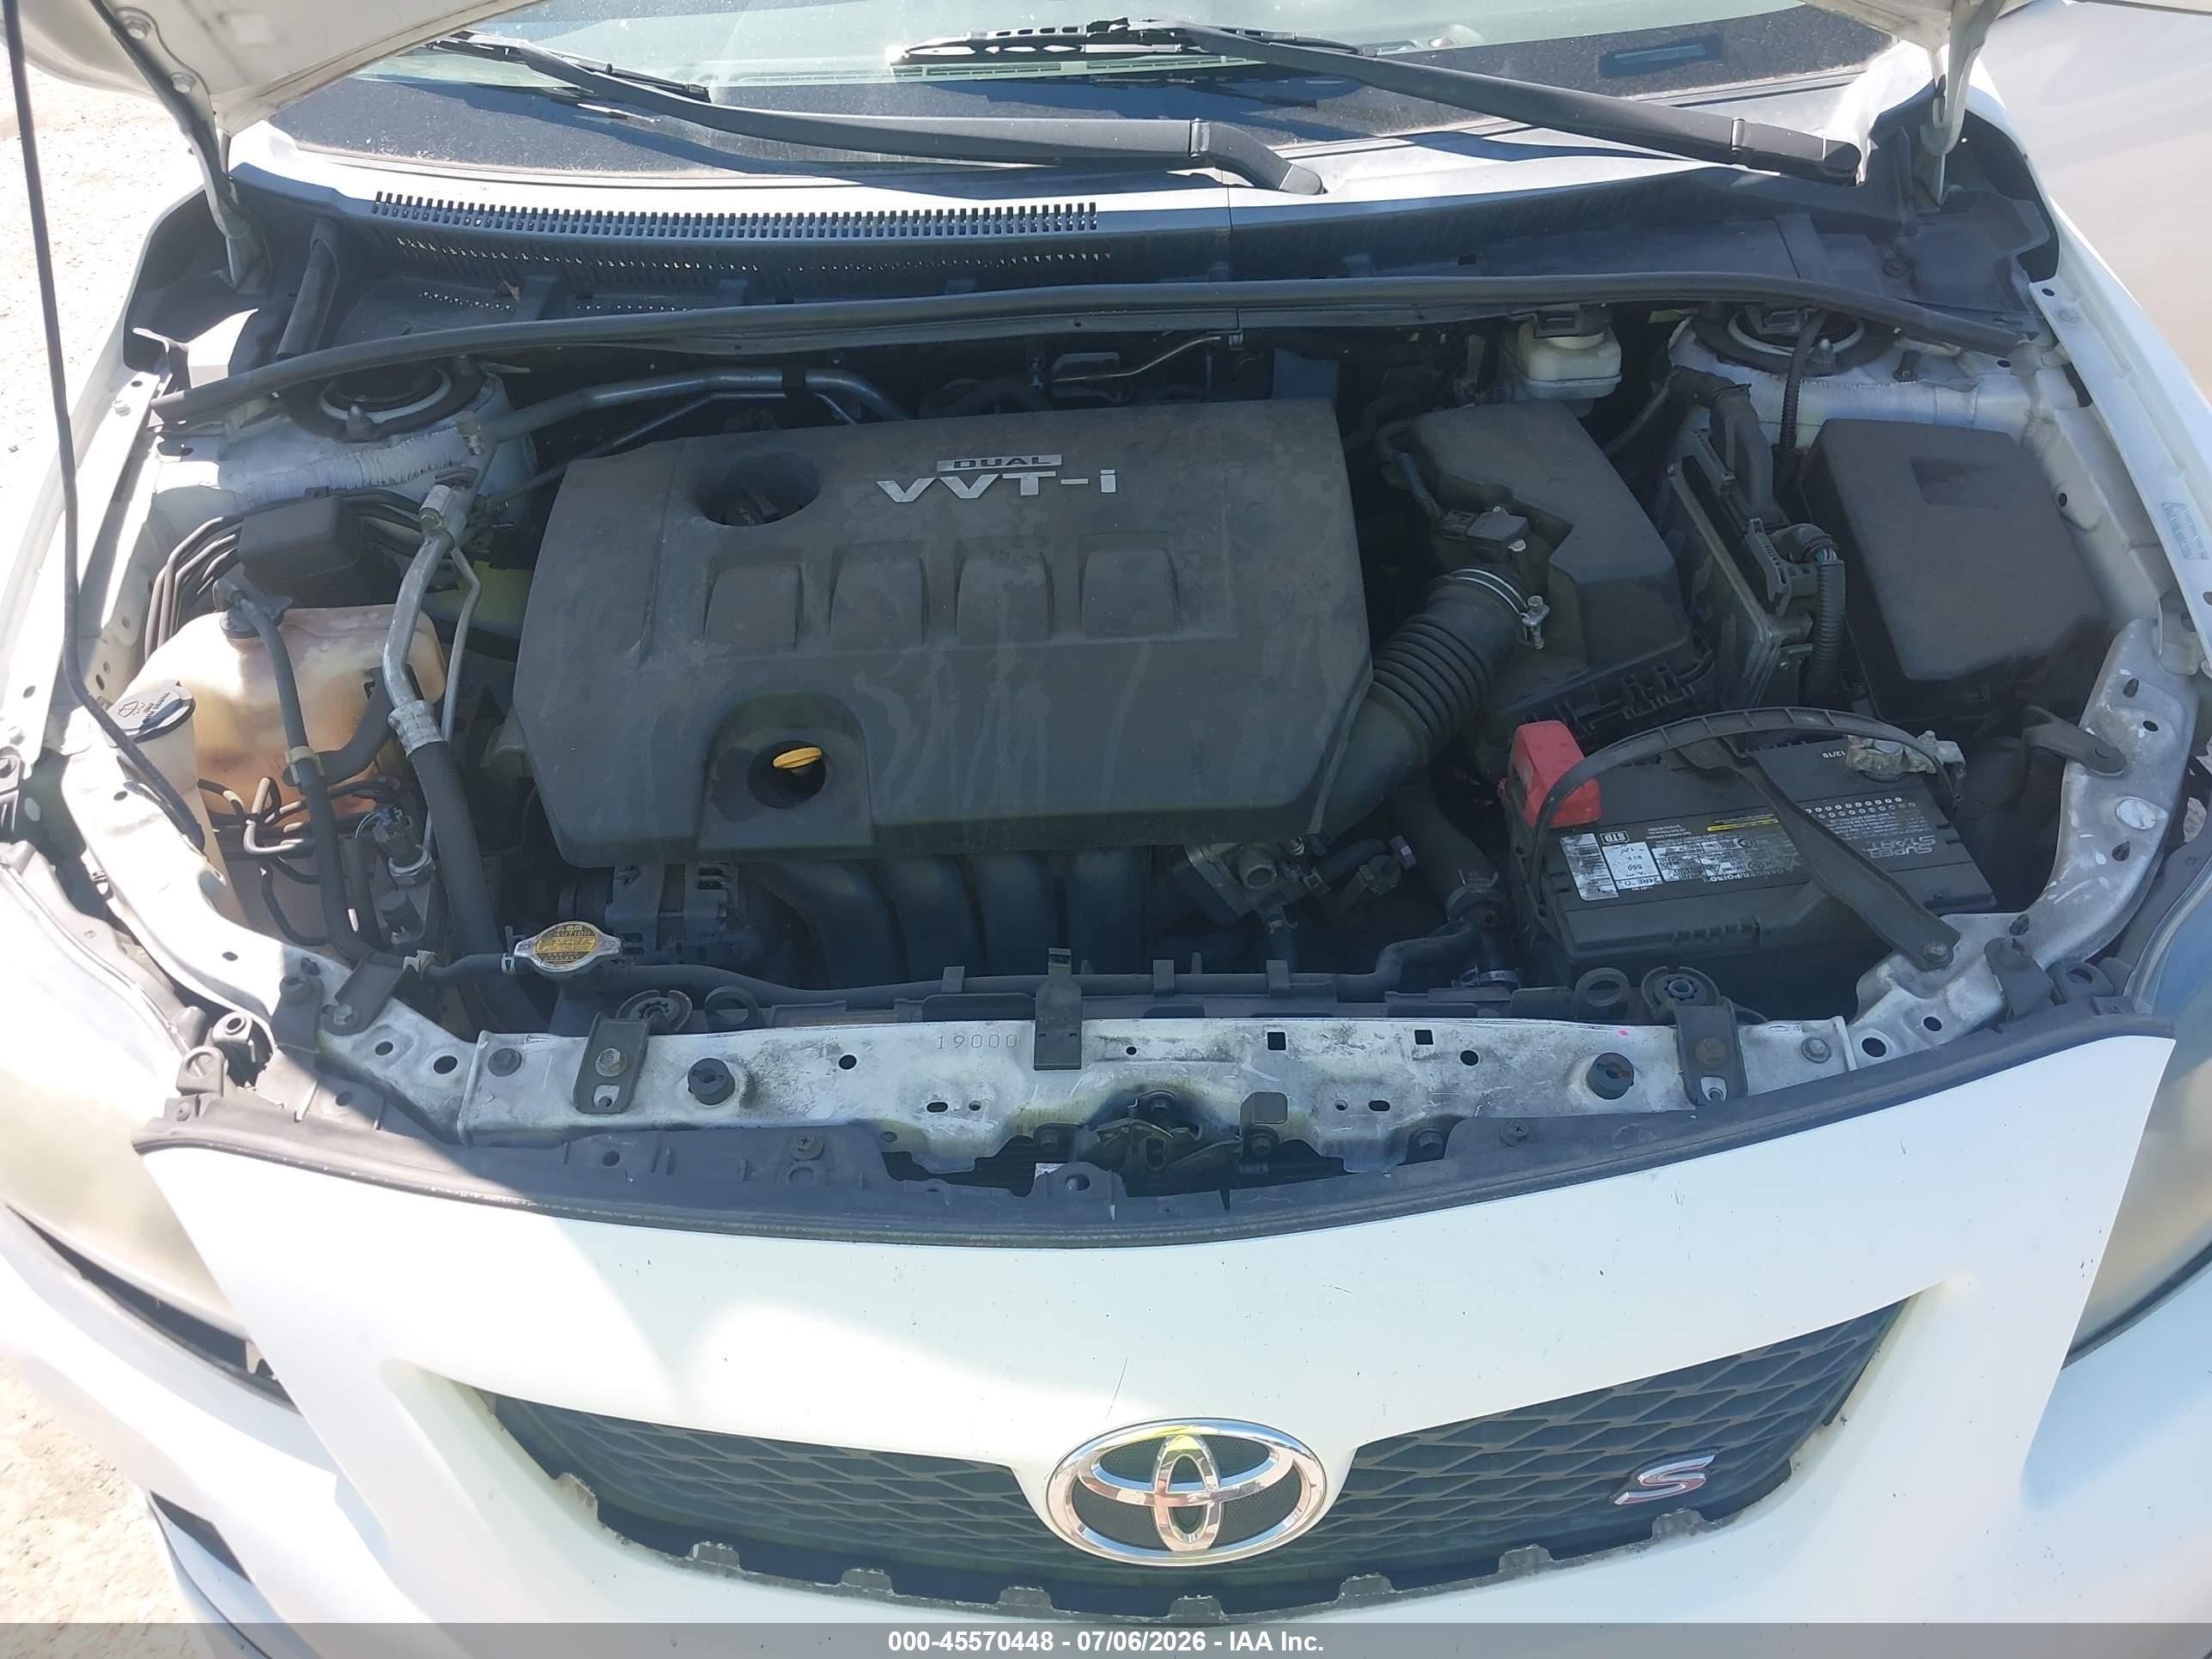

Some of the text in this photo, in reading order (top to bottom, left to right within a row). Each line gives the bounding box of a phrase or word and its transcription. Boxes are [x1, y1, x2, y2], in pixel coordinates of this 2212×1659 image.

[951, 456, 1054, 470] DUAL
[876, 470, 1116, 502] VVT-i
[1604, 832, 1627, 843] STD
[1869, 843, 1933, 859] SUPER
[937, 1033, 1018, 1050] 19000
